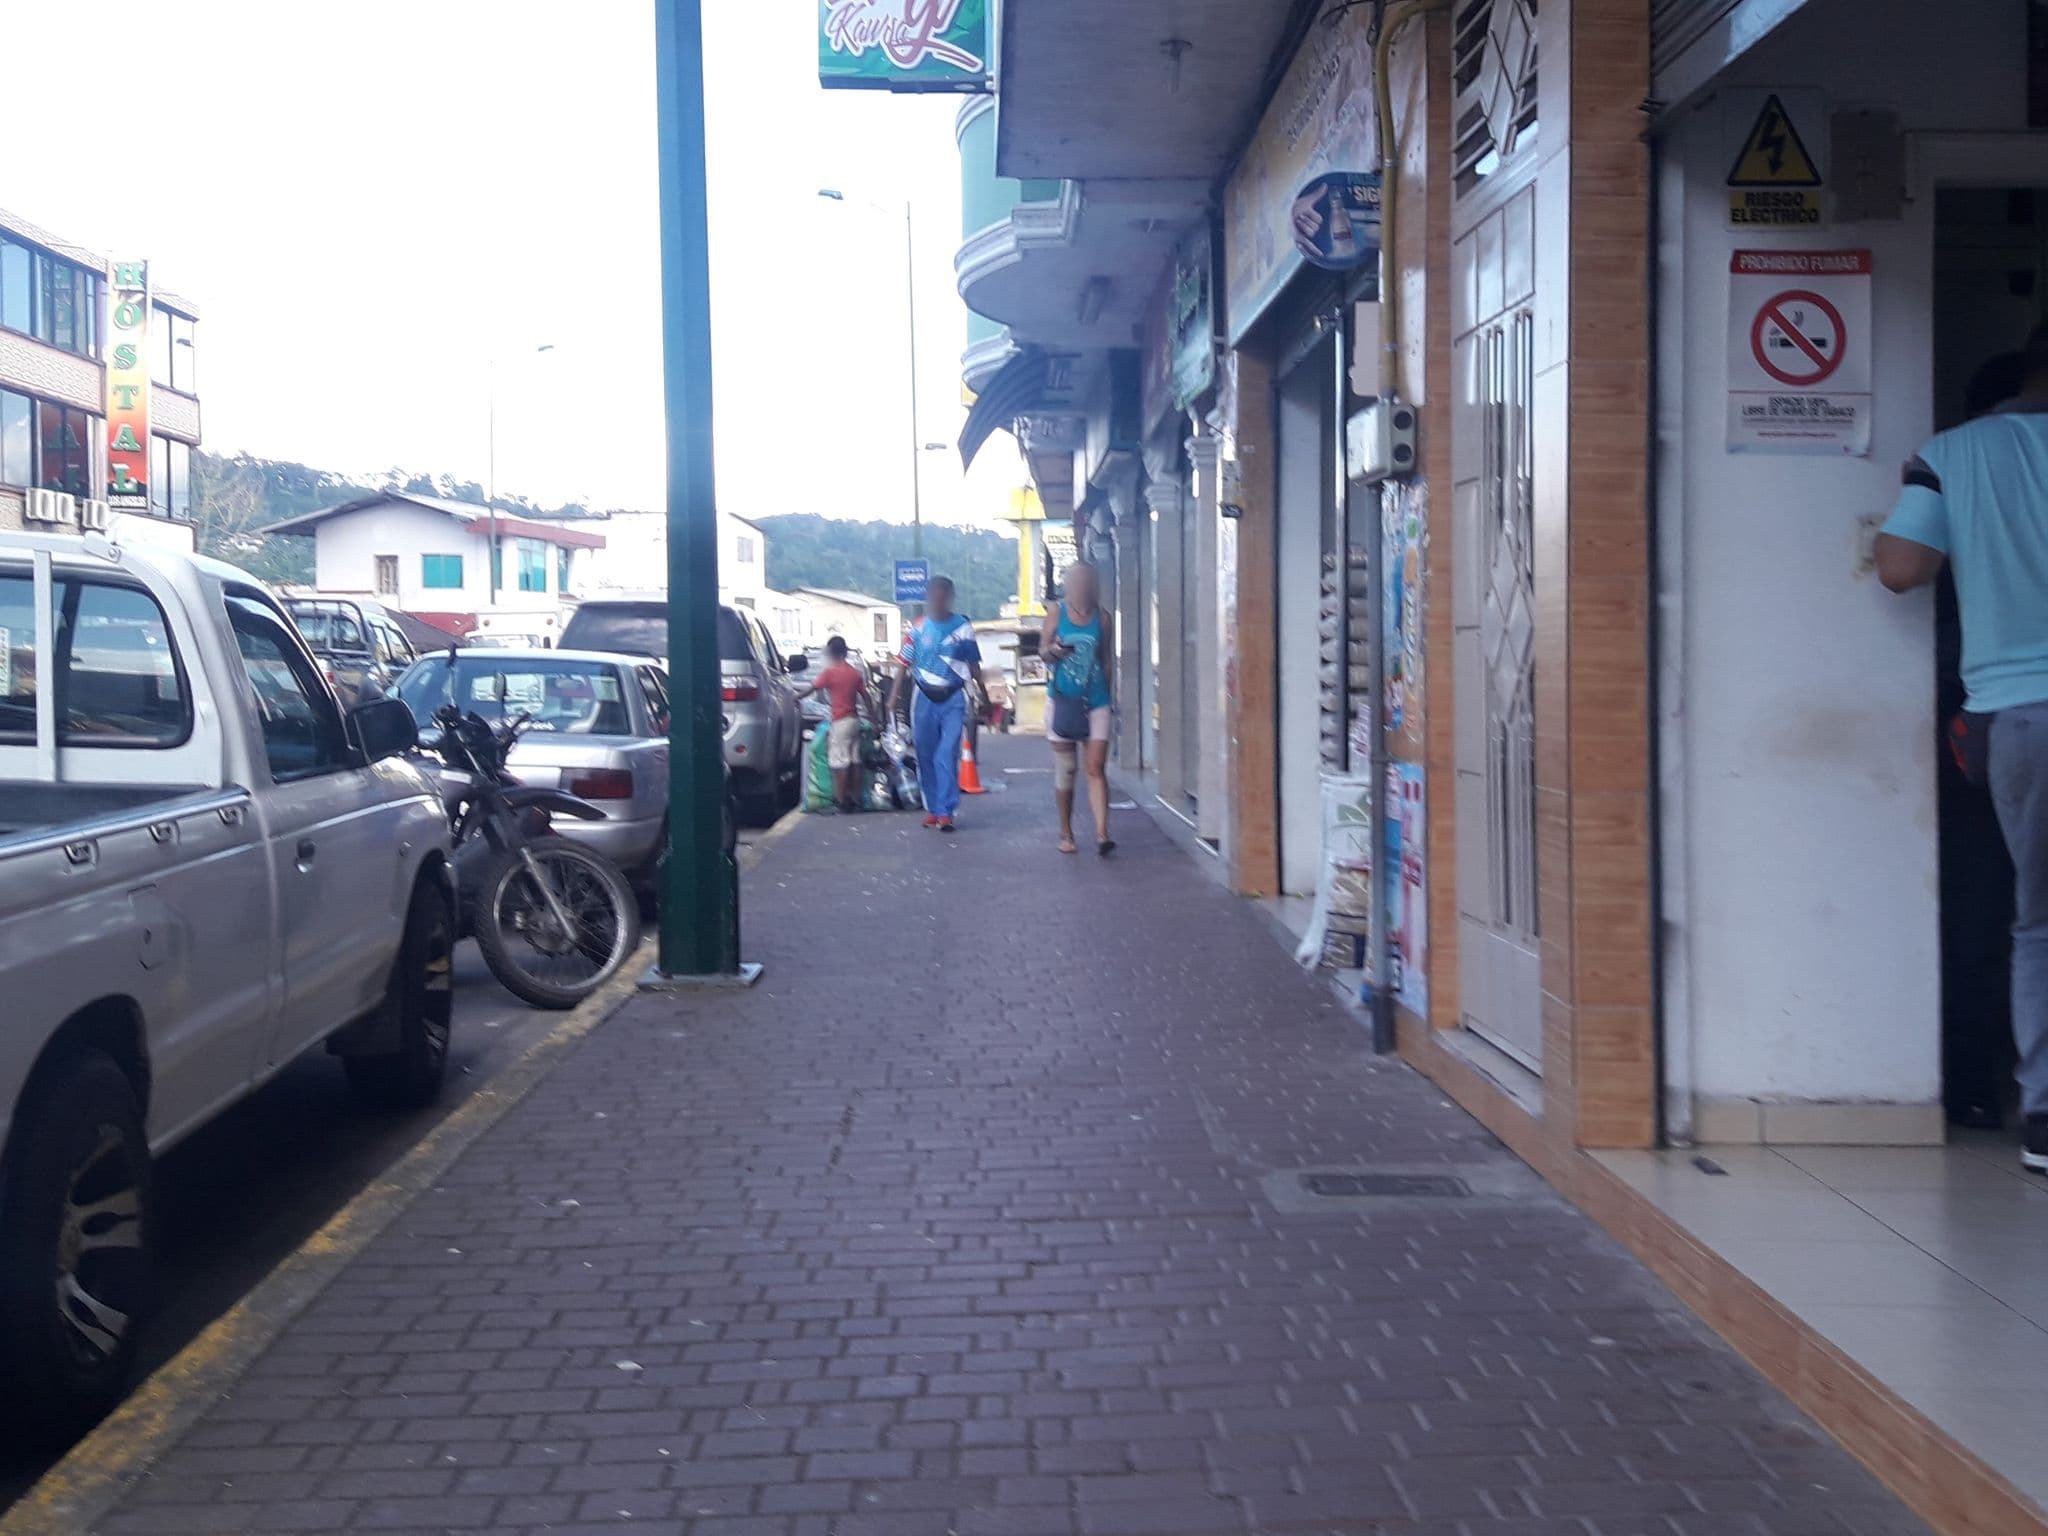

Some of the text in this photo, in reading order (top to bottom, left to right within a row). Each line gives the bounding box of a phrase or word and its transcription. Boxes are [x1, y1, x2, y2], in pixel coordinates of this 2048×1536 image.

[1744, 191, 1804, 207] RIESGO
[1739, 255, 1861, 271] PROHIBIDO FUMAR
[111, 264, 145, 493] HOSTAL
